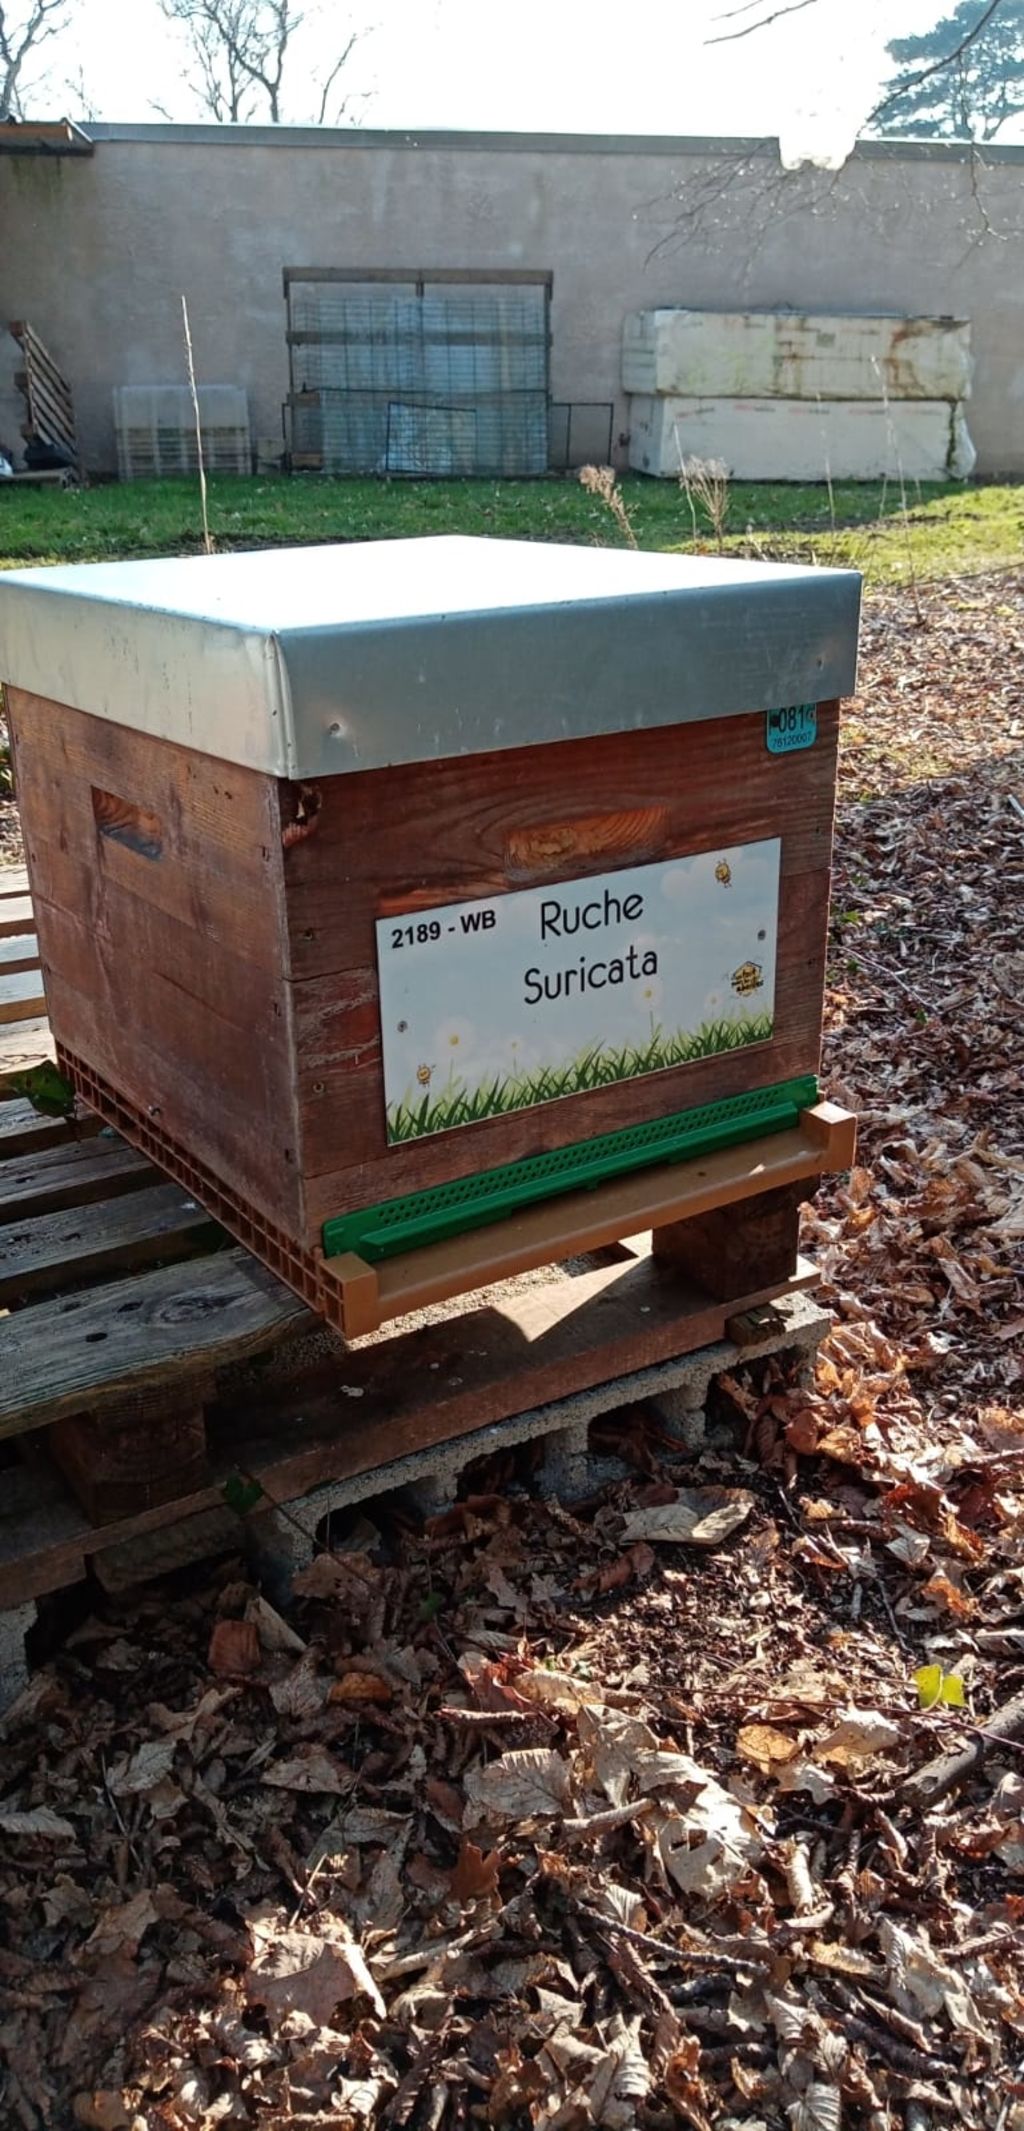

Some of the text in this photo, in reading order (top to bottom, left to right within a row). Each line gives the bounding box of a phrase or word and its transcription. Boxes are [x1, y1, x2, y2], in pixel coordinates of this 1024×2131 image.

[391, 921, 441, 949] 2189
[460, 909, 497, 934] WB
[540, 889, 643, 940] Ruche
[524, 944, 658, 1005] Suricata
